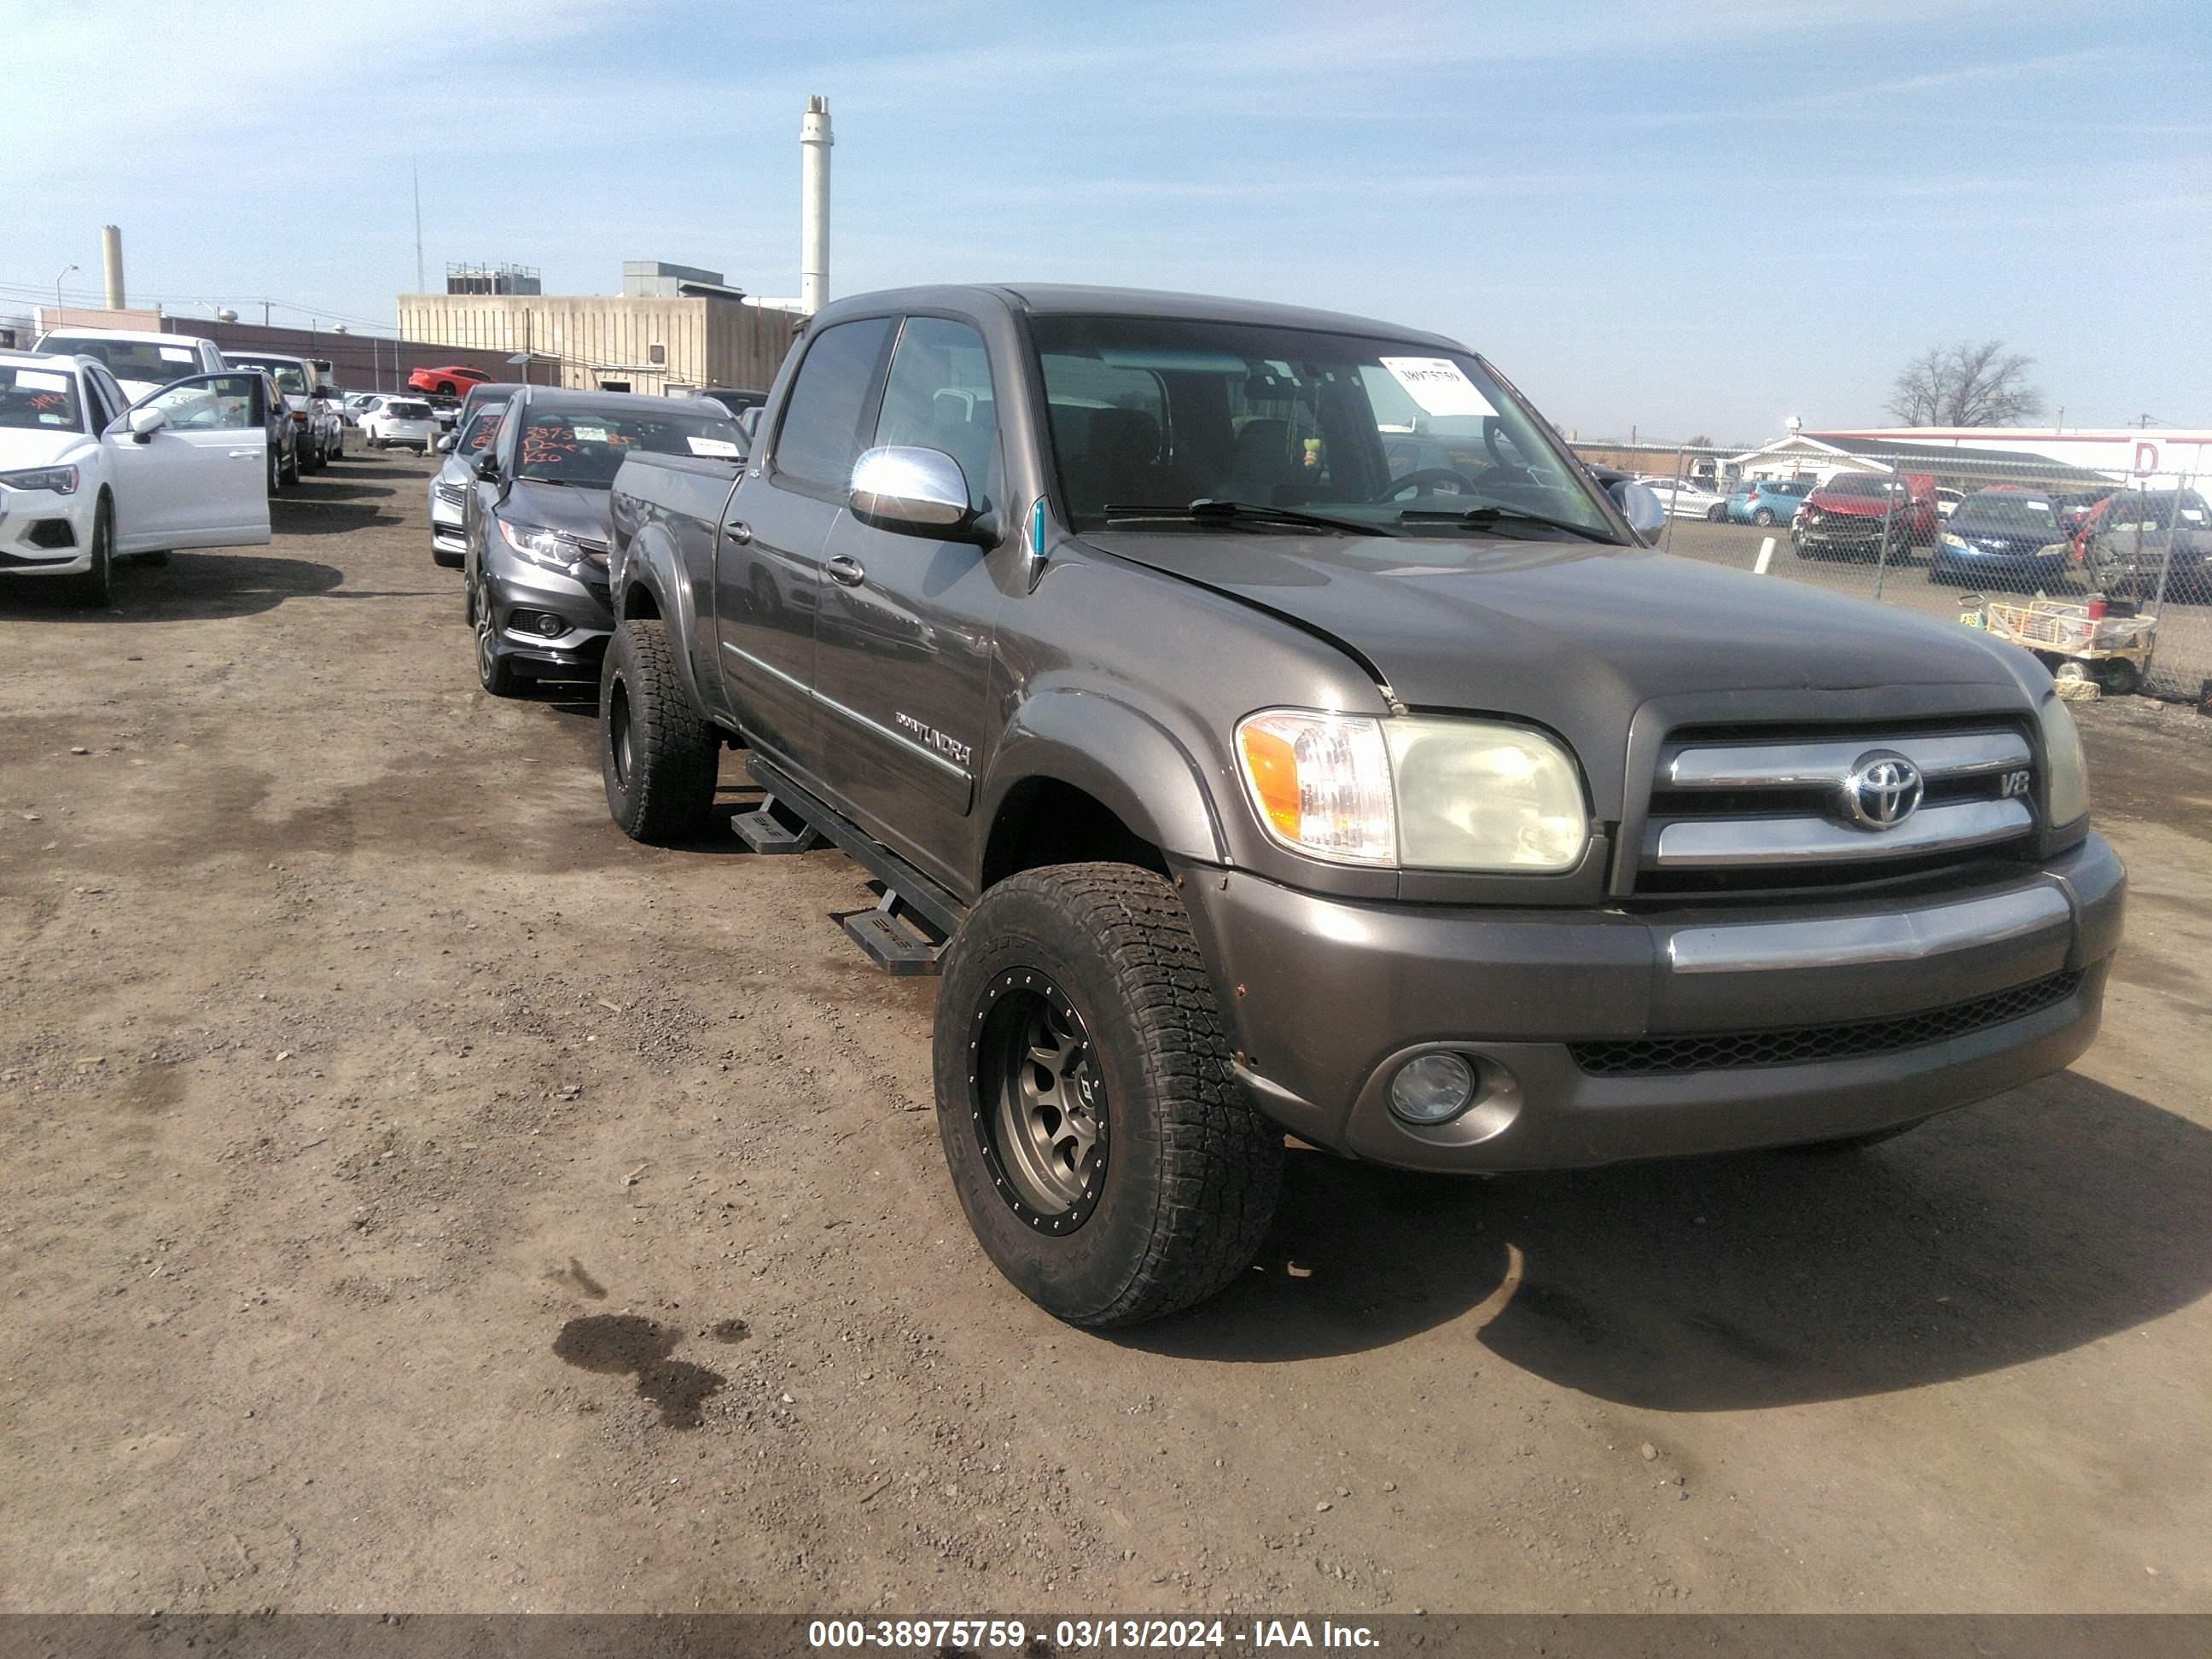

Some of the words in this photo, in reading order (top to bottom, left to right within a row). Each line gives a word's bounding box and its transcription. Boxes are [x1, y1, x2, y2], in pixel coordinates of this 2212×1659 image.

[2133, 442, 2159, 478] D
[917, 722, 973, 765] TUNDRA
[2000, 770, 2031, 797] V8
